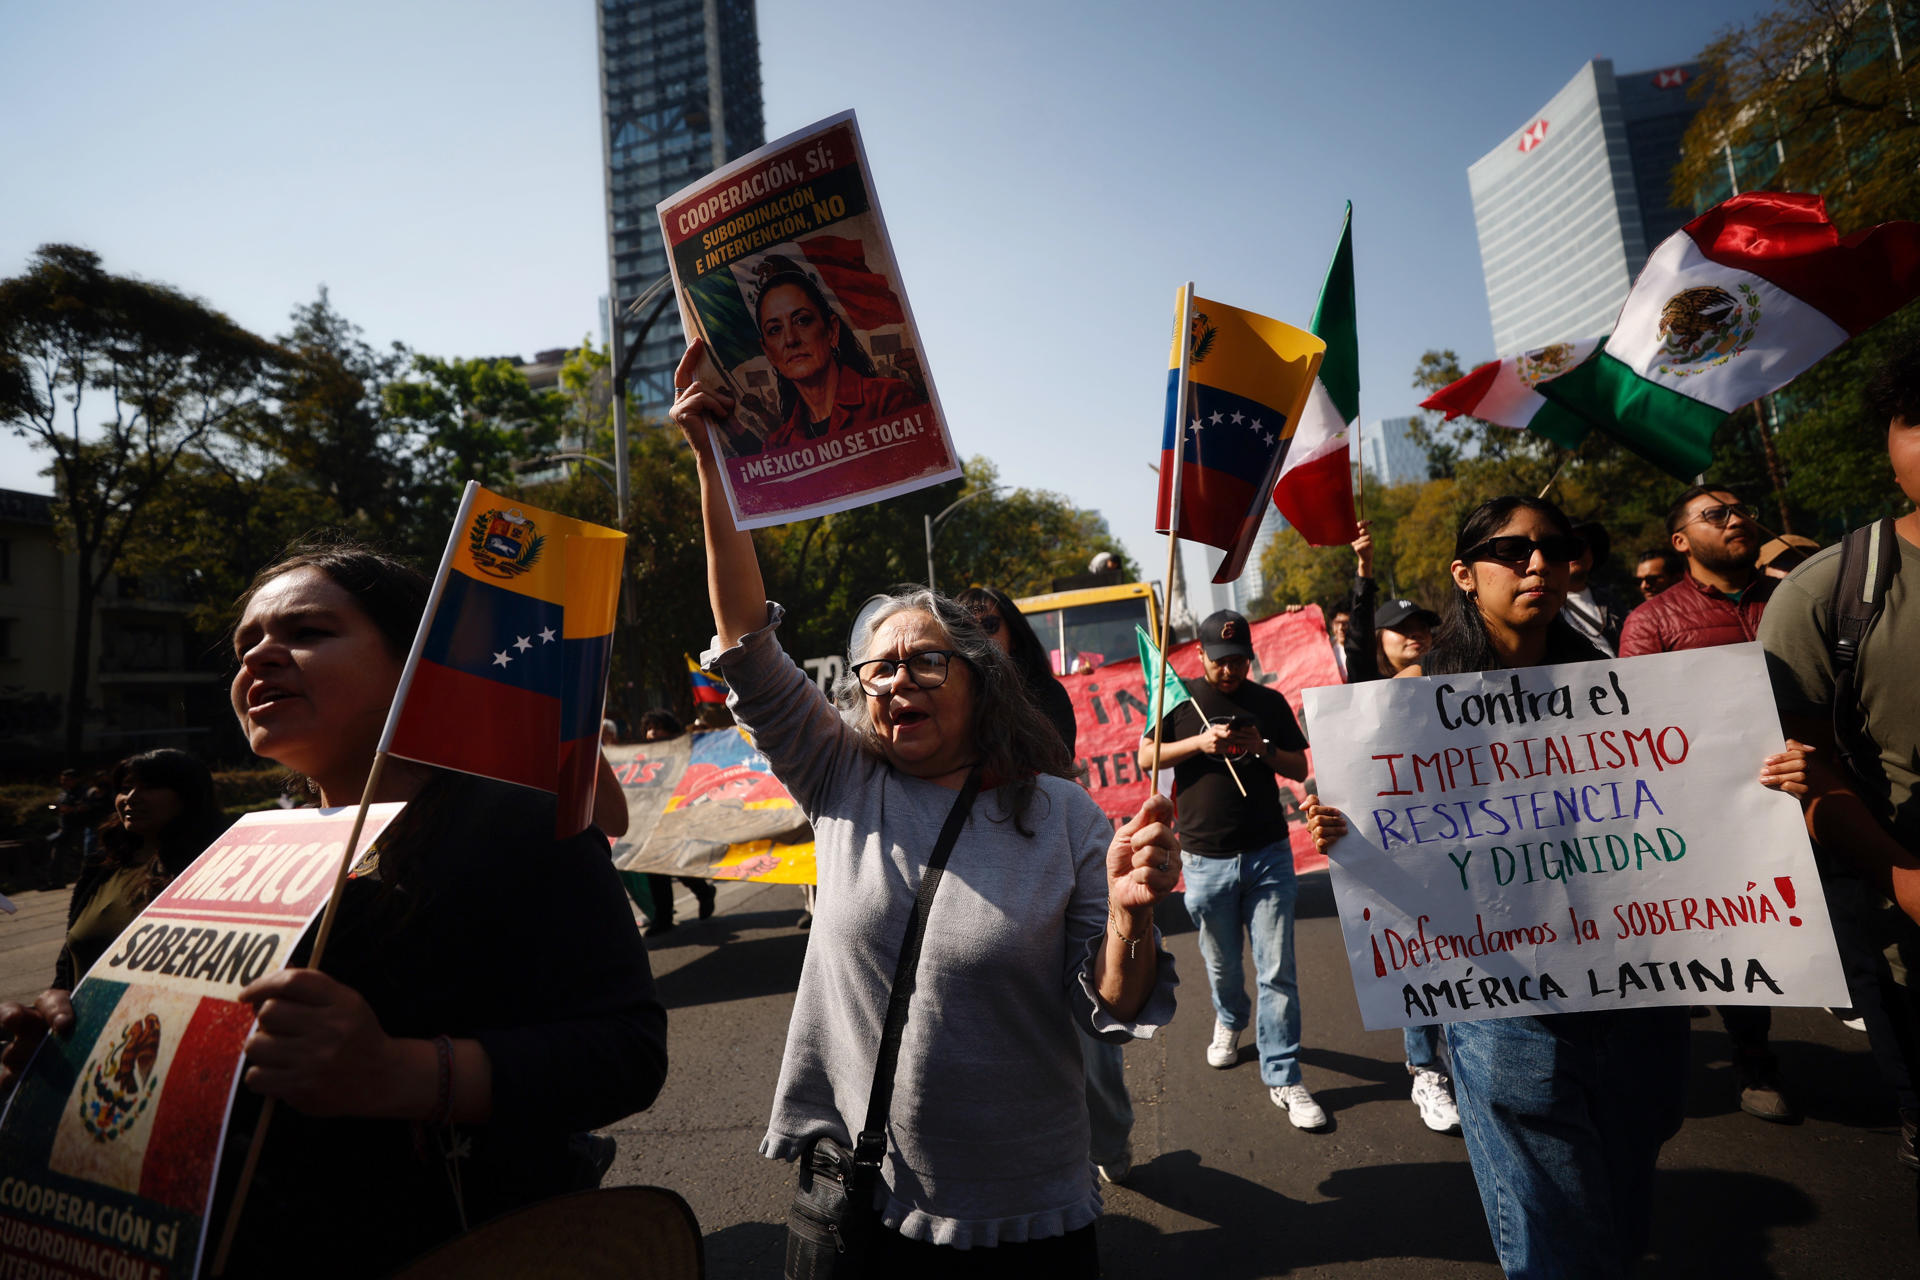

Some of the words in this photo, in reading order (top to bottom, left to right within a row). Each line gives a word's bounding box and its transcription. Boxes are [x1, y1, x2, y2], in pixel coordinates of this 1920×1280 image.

[678, 160, 804, 235] COOPERACIÓN,
[805, 140, 835, 174] SÍ;
[702, 186, 815, 251] SUBORDINACIÓN
[695, 258, 705, 275] E
[706, 212, 812, 269] INTERVENCIÓN,
[811, 195, 846, 225] NO
[740, 447, 816, 483] ¡MÉXICO
[817, 439, 843, 462] NO
[844, 432, 868, 454] SE
[868, 413, 925, 448] TOCA!
[1436, 673, 1574, 731] Contra
[1588, 670, 1630, 716] el
[1371, 726, 1689, 797] IMPERIALISMO
[1372, 779, 1664, 850] RESISTENCIA
[171, 831, 345, 905] MÉXICO
[1447, 850, 1473, 890] Y
[1490, 826, 1687, 887] DIGNIDAD
[109, 923, 280, 988] SOBERANO
[1363, 907, 1559, 978] ¡Defendamos
[1568, 907, 1600, 944] la
[1612, 875, 1804, 940] SOBERANÍA!
[1401, 966, 1568, 1018] AMÉRICA
[1587, 957, 1784, 998] LATINA
[0, 1176, 150, 1250] COOPERACIÓN
[153, 1219, 181, 1260] SÍ
